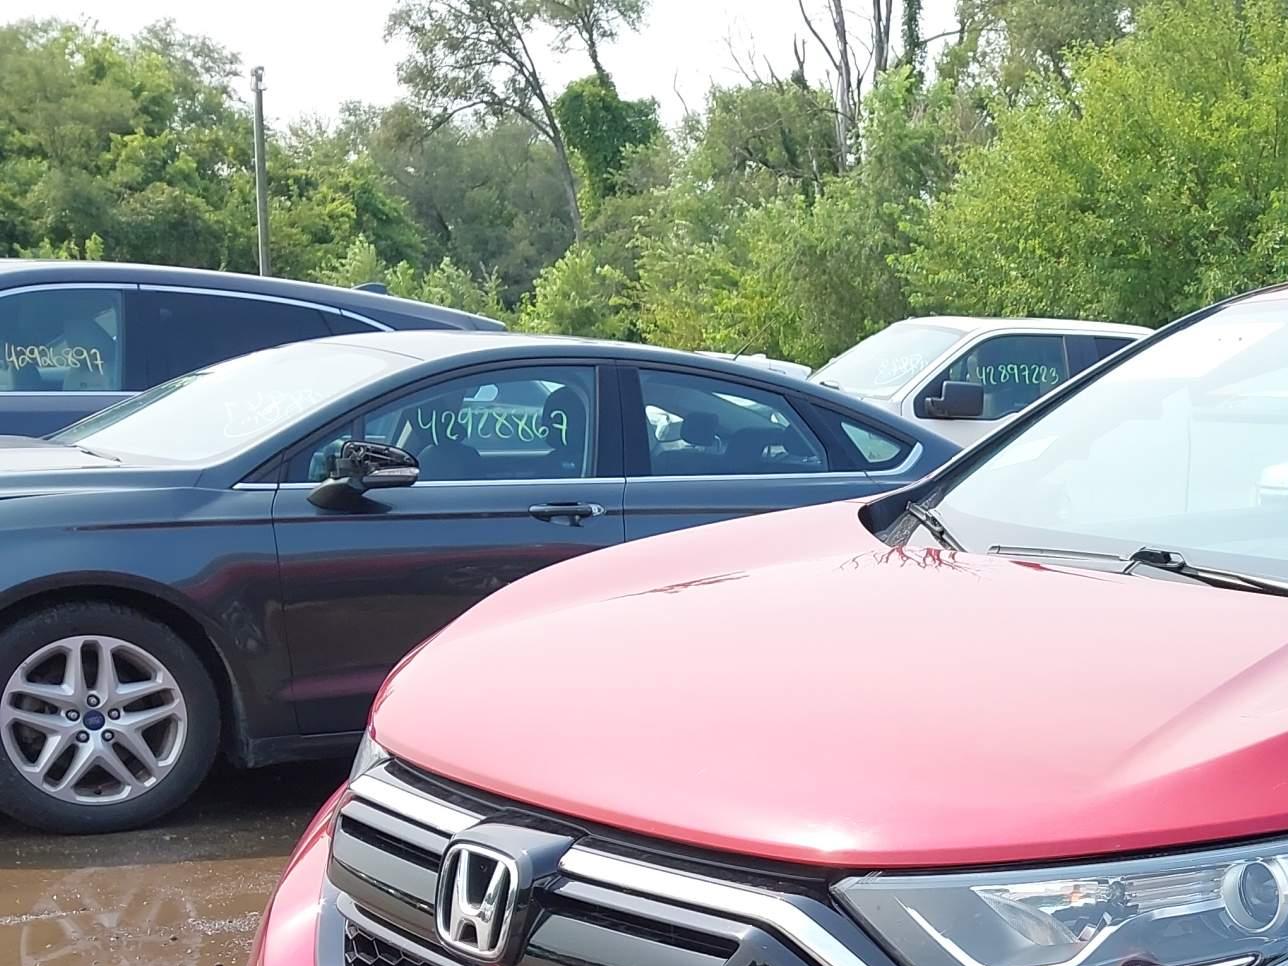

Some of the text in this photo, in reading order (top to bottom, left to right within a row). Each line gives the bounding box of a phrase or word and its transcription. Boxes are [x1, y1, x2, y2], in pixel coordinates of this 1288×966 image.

[4, 342, 105, 376] 42926897
[975, 363, 1060, 385] 42897223
[417, 407, 568, 446] 42928867
